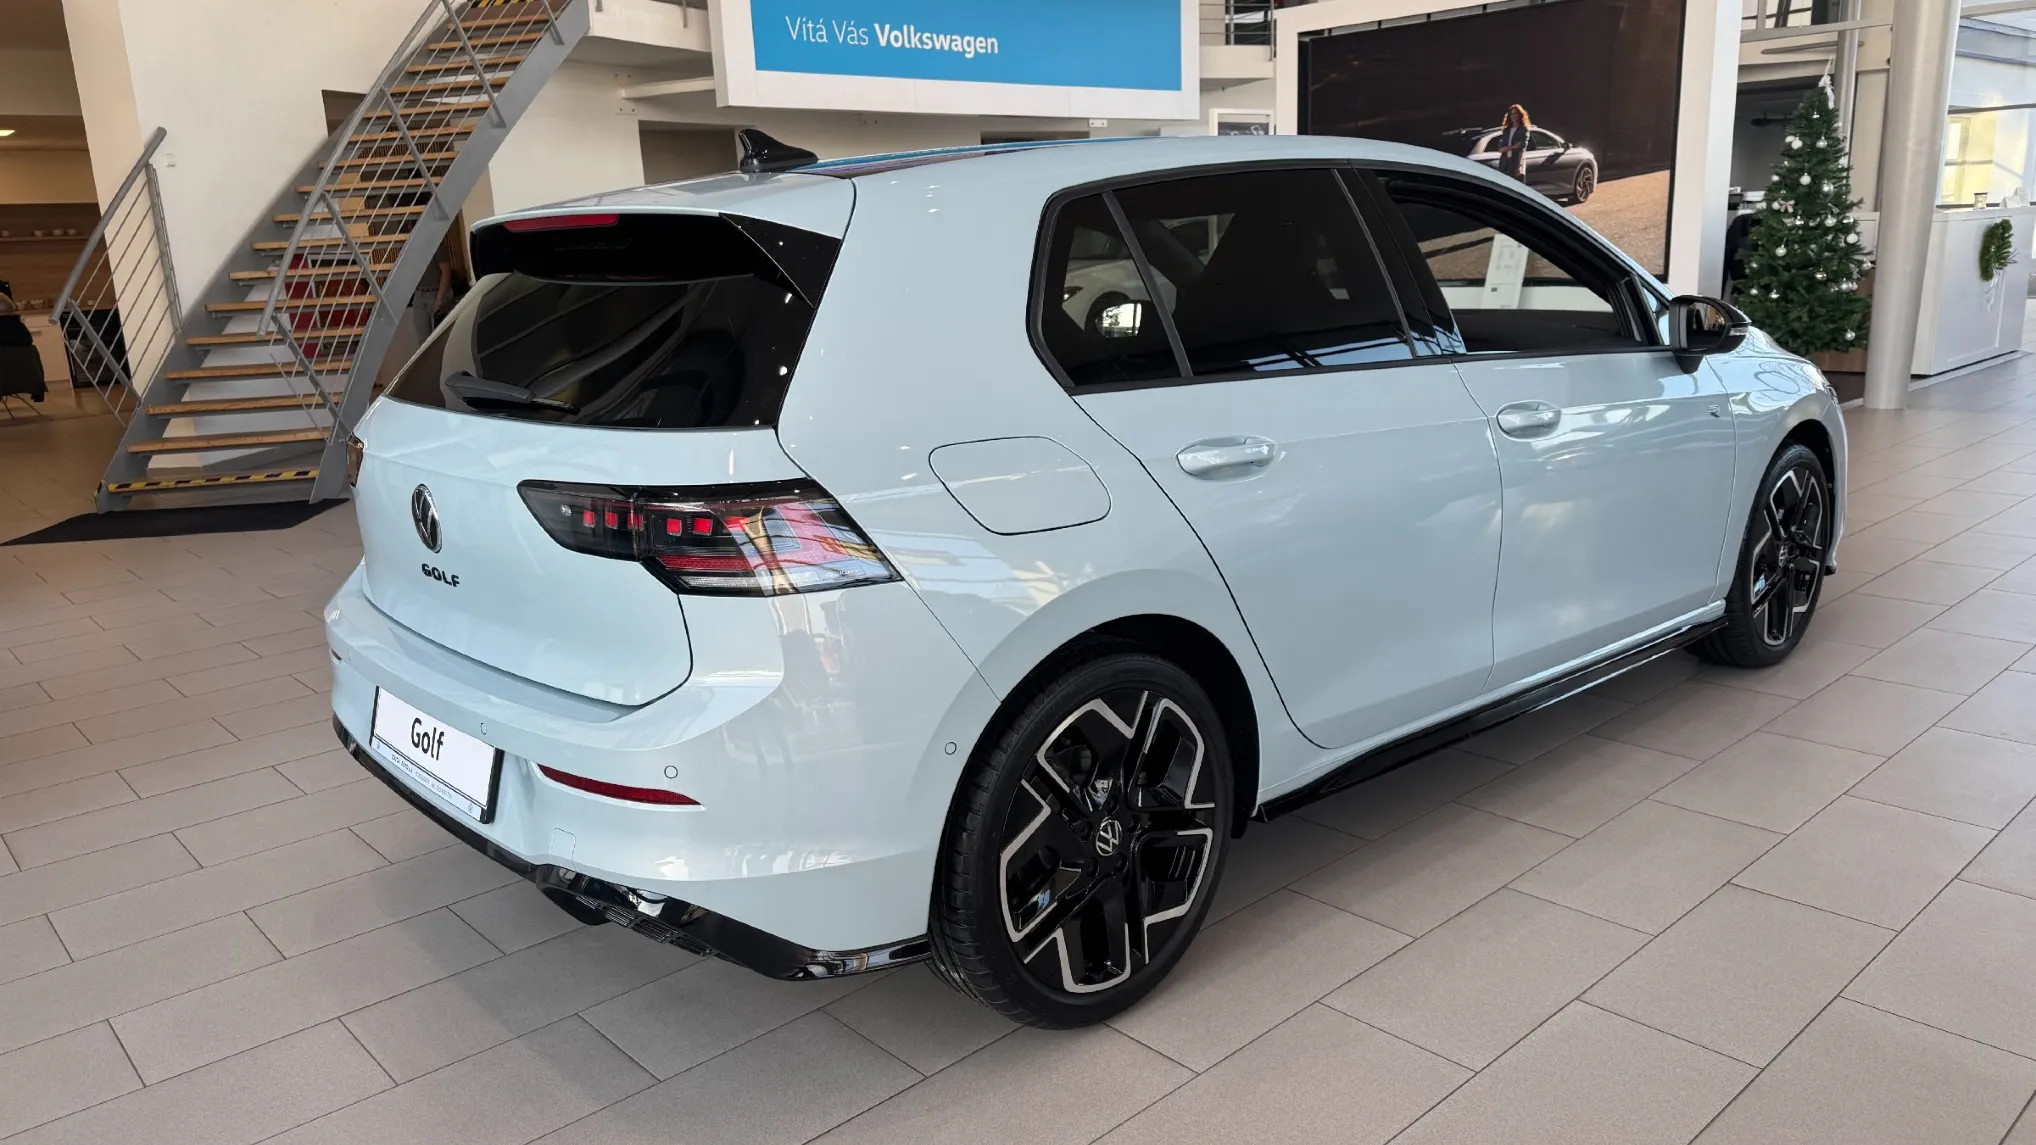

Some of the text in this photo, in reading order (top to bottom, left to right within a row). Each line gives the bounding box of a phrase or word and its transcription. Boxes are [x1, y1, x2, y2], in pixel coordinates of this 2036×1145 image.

[785, 16, 998, 58] Vítá Vás Volkswagen
[421, 563, 460, 587] GOLF
[411, 717, 445, 761] Golf
